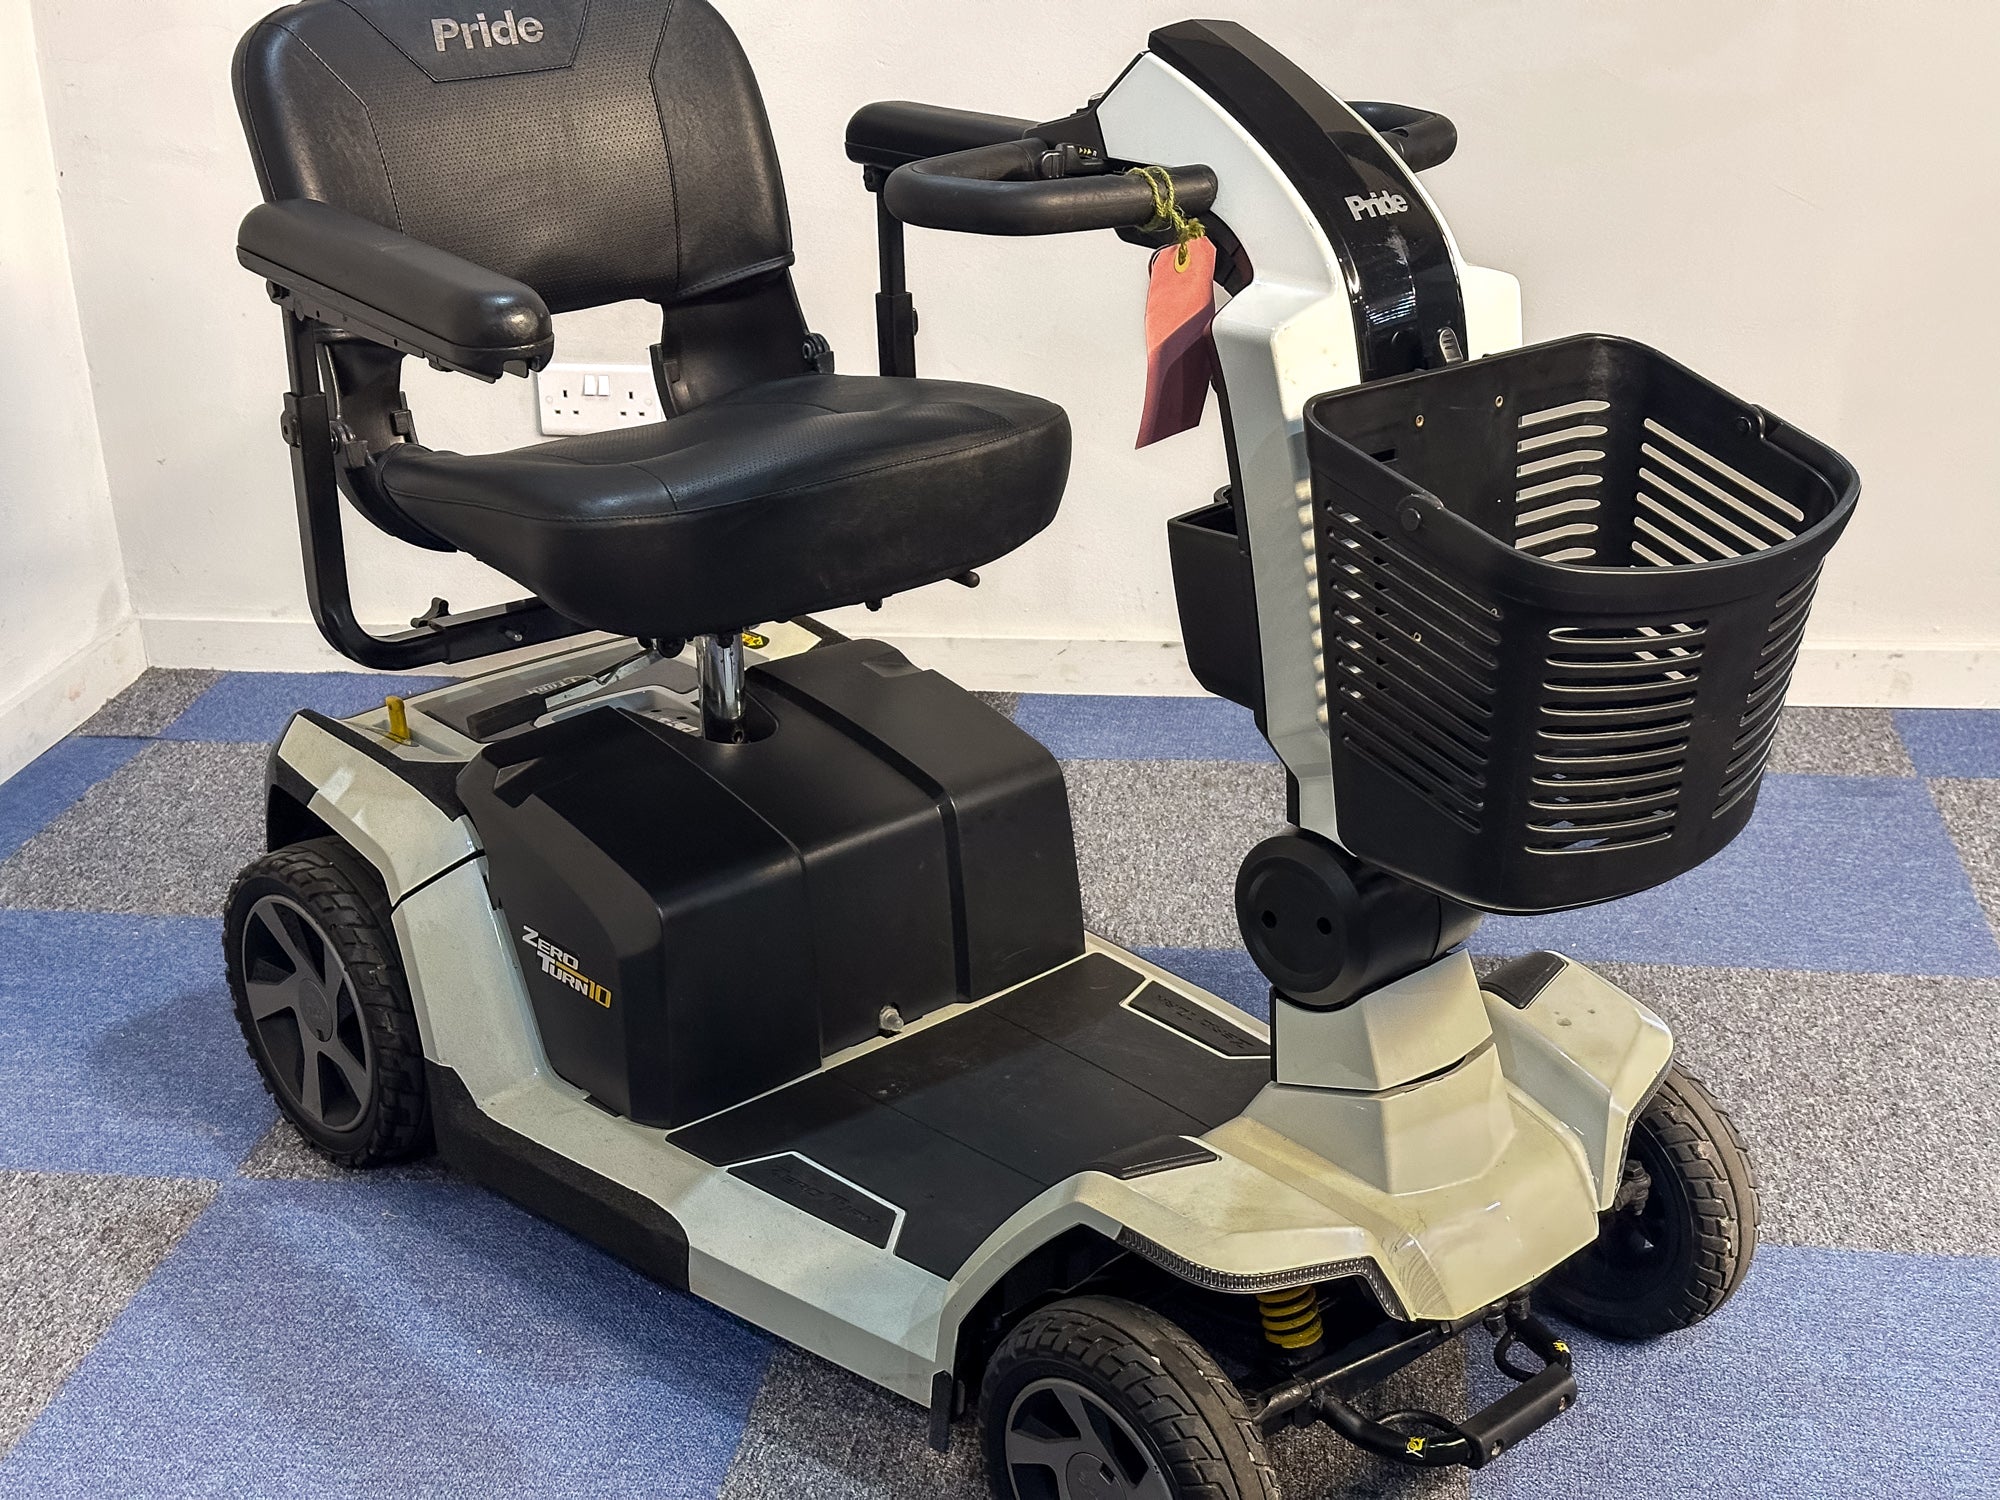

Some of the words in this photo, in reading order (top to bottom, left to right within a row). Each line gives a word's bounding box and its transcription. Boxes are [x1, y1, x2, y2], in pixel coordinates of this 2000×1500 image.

[431, 9, 544, 52] Pride
[1344, 190, 1408, 221] Pride
[522, 925, 579, 971] ZERO
